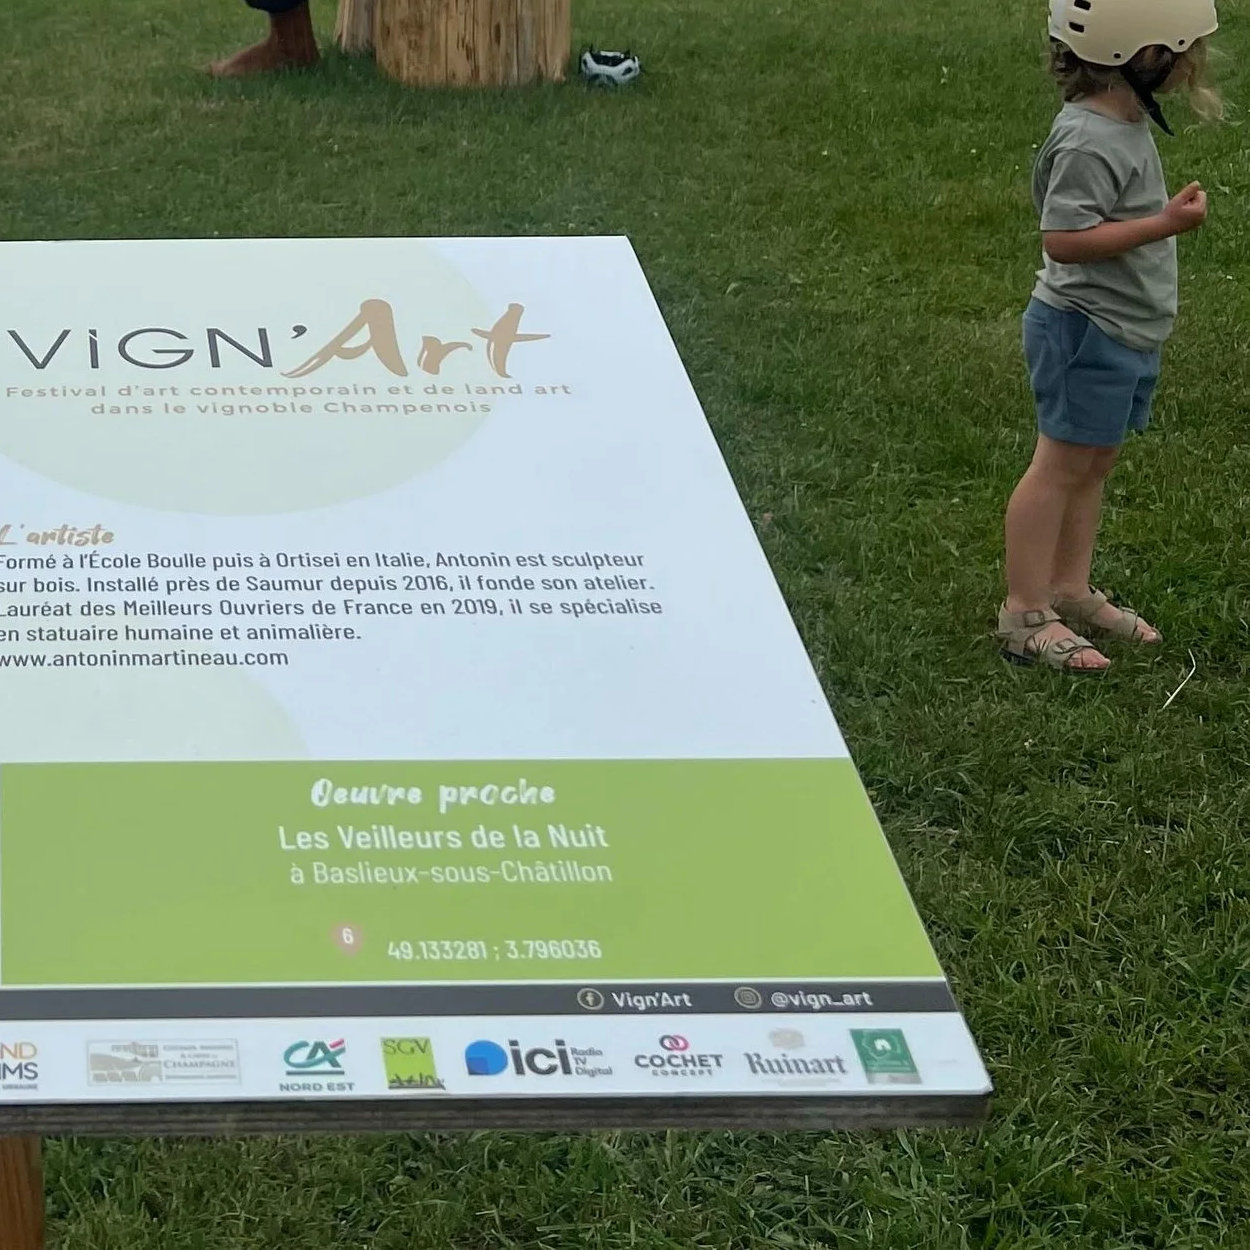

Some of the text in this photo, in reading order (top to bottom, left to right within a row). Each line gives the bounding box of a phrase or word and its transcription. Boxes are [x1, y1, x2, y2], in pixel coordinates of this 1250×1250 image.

[6, 383, 572, 398] Festival d'art contemporain et de land art
[91, 401, 492, 417] dans le vignoble Champenois
[62, 554, 74, 570] à
[80, 550, 142, 569] l'École
[147, 553, 207, 569] Boulle
[213, 553, 254, 572] puis
[259, 553, 271, 568] à
[276, 552, 341, 568] Ortisei
[346, 556, 371, 568] en
[375, 552, 431, 569] Italie,
[436, 552, 511, 568] Antonin
[516, 553, 548, 568] est
[551, 552, 644, 571] sculpteur
[34, 577, 81, 593] bois.
[87, 576, 159, 593] Installé
[166, 576, 211, 596] près
[216, 576, 240, 592] de
[246, 576, 324, 592] Saumur
[330, 575, 398, 595] depuis
[402, 575, 454, 592] 2016,
[458, 575, 472, 591] il
[477, 575, 535, 591] fonde
[541, 579, 578, 591] son
[584, 575, 655, 591] atelier.
[80, 601, 116, 617] des
[124, 600, 213, 616] Meilleurs
[220, 600, 305, 616] Ouvriers
[312, 600, 337, 616] de
[343, 599, 413, 615] France
[421, 603, 446, 615] en
[451, 599, 504, 616] 2019,
[509, 599, 523, 615] il
[529, 603, 553, 615] se
[560, 598, 663, 619] spécialise
[439, 778, 556, 815] proche
[278, 823, 610, 850] Les Veilleurs de la Nuit
[290, 860, 614, 885] à Baslieux-sous-Châtillon
[342, 927, 354, 945] 6
[388, 939, 603, 960] 49.133281 3.796036
[611, 991, 693, 1011] Vign'Art
[771, 991, 874, 1011] @vign_art
[382, 1038, 432, 1055] SGV
[508, 1038, 573, 1076] ici
[634, 1053, 723, 1068] COCHET
[744, 1052, 848, 1075] Ruinart
[279, 1082, 355, 1092] NORD EST
